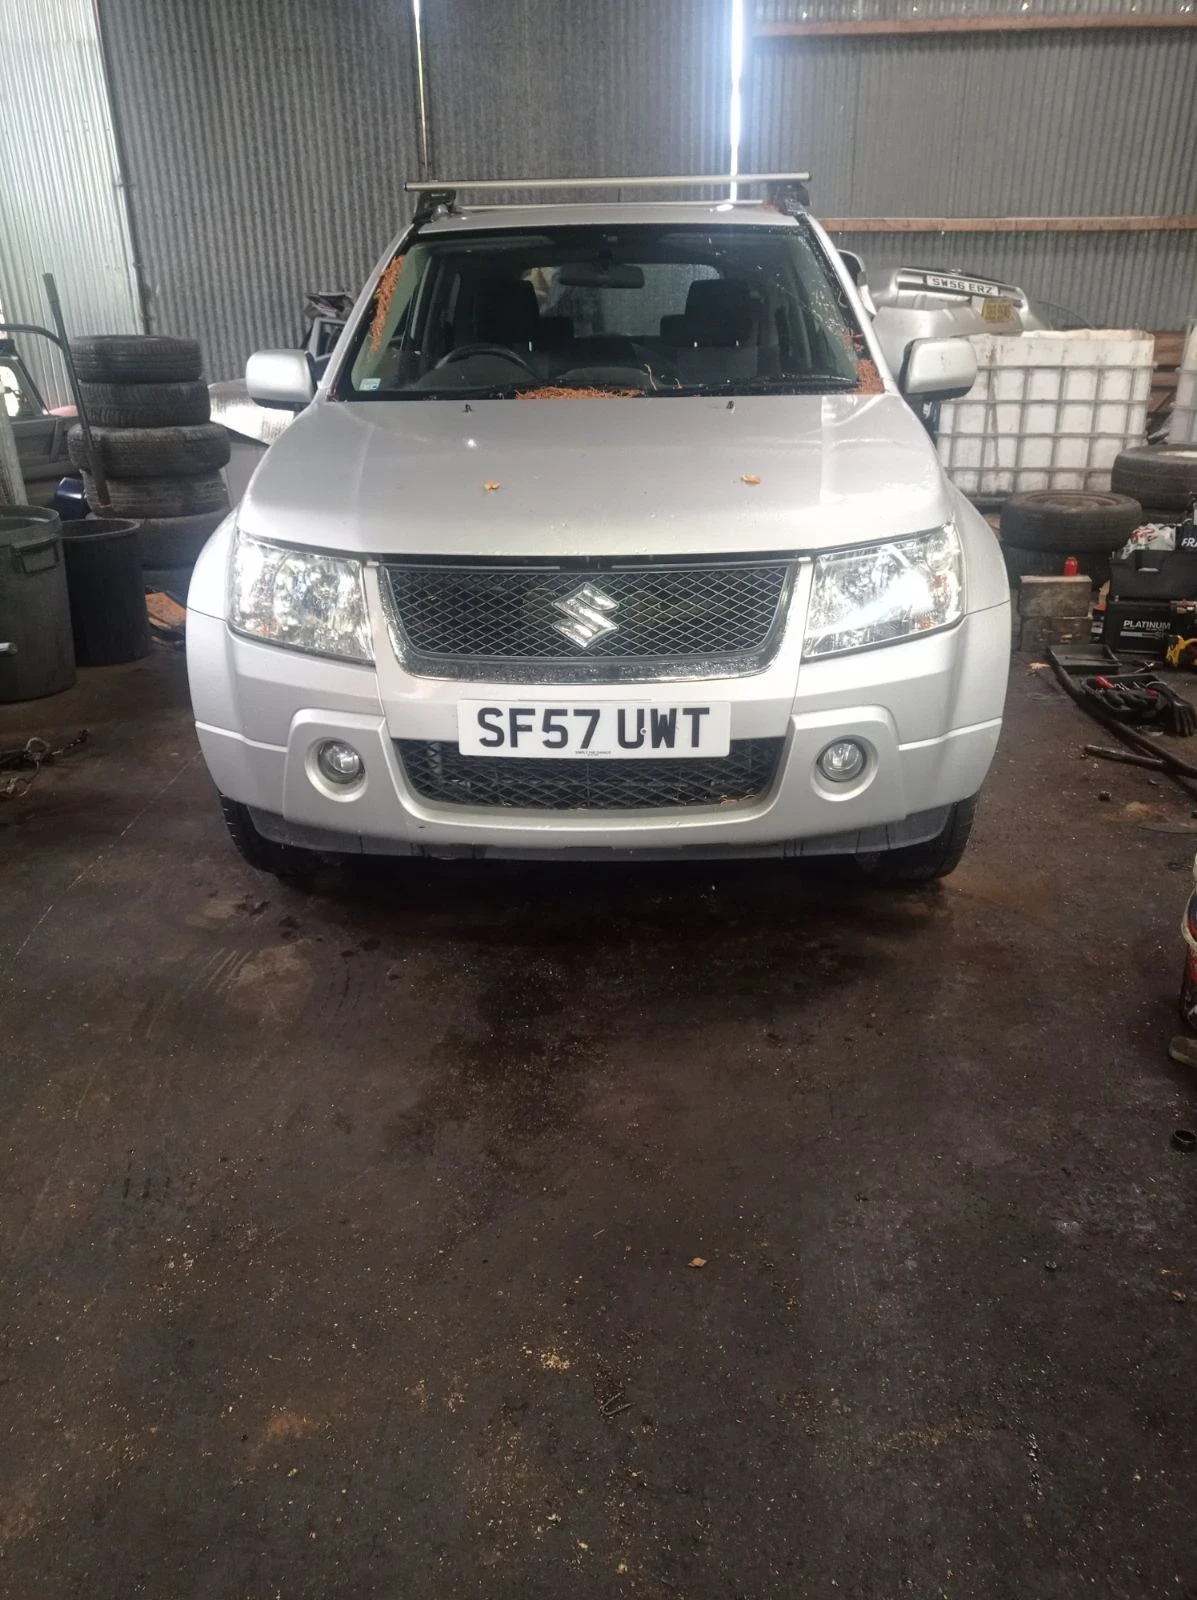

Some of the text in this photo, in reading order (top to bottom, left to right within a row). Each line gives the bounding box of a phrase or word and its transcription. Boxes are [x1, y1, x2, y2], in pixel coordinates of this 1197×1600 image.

[932, 278, 993, 294] SW56 ERZ
[1123, 619, 1171, 629] PLATINUM
[477, 707, 710, 749] SF57 UWT
